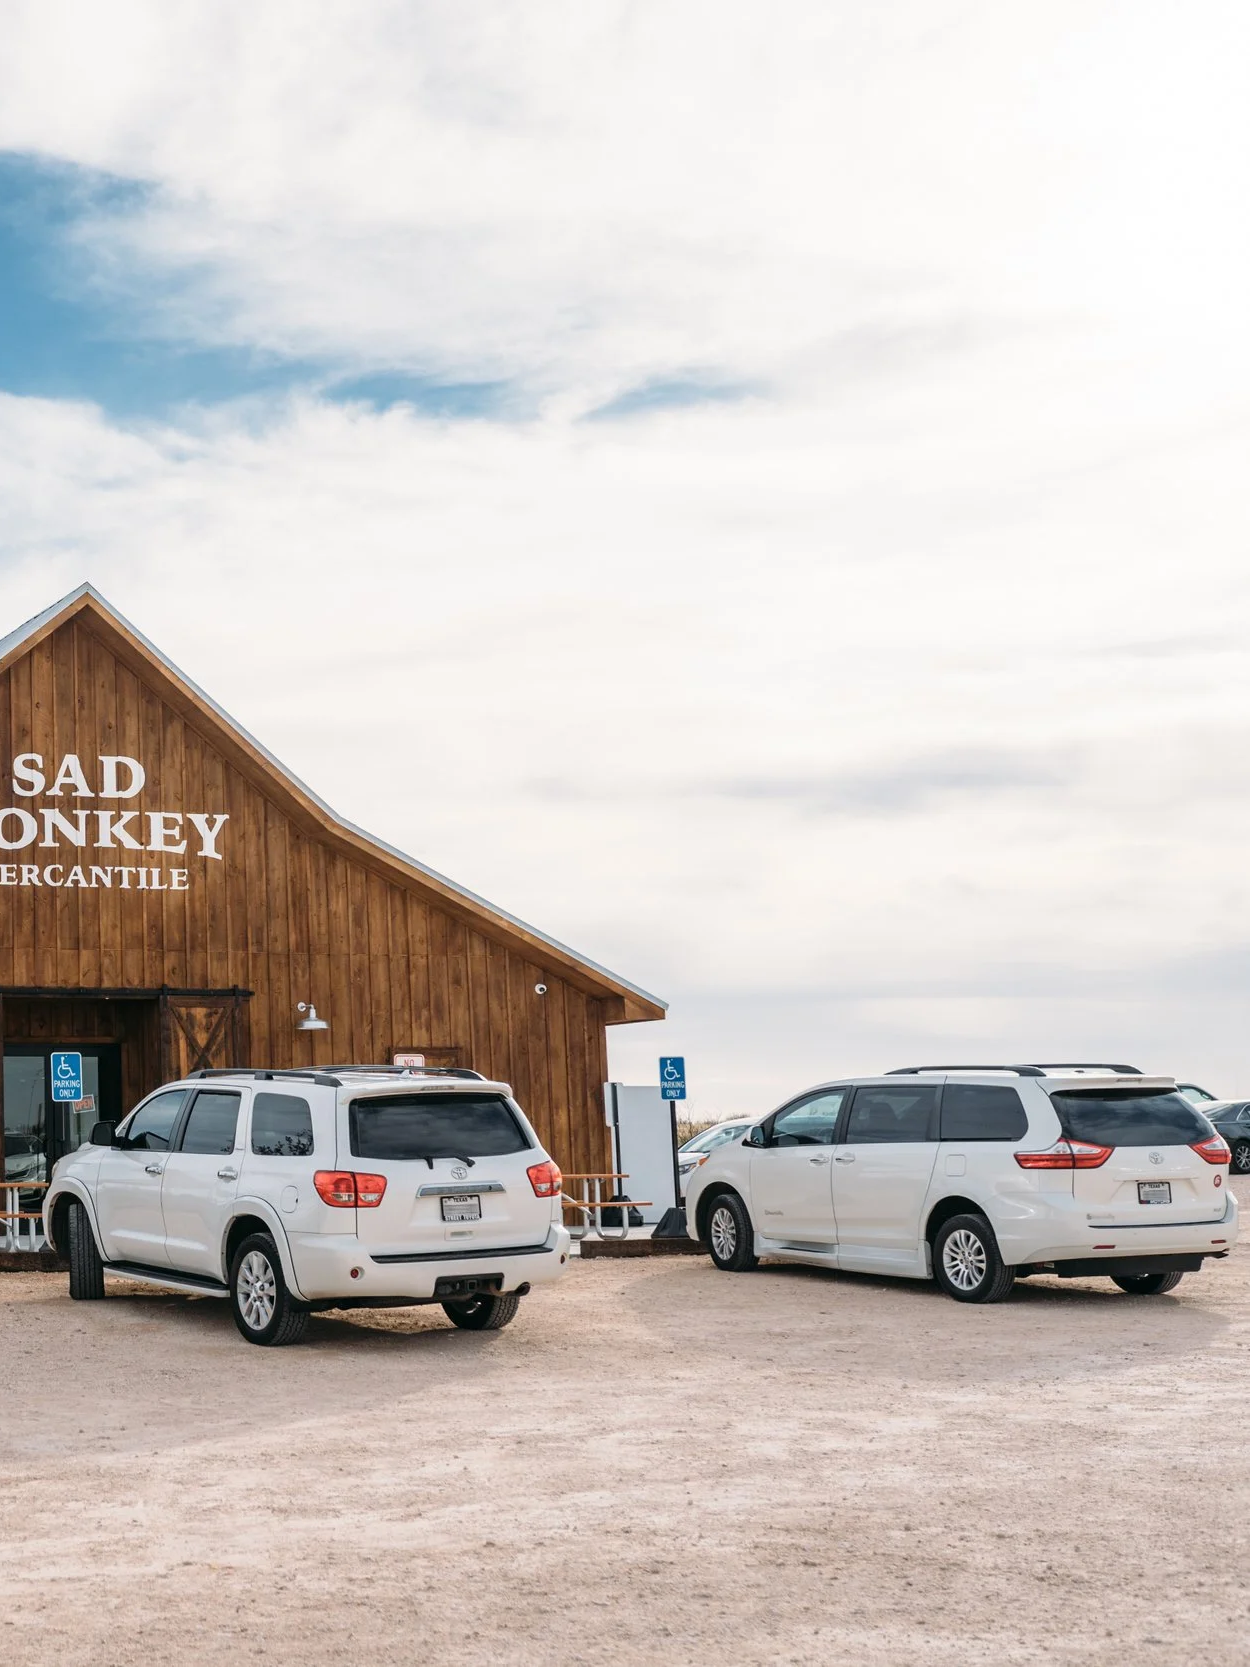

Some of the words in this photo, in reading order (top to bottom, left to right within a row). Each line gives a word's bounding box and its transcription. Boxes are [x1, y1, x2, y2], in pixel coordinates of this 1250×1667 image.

[12, 752, 146, 799] SAD
[403, 1059, 415, 1067] NO
[53, 1079, 81, 1088] PARKING
[661, 1080, 685, 1089] PARKING
[59, 1088, 76, 1098] ONLY
[666, 1089, 681, 1097] ONLY
